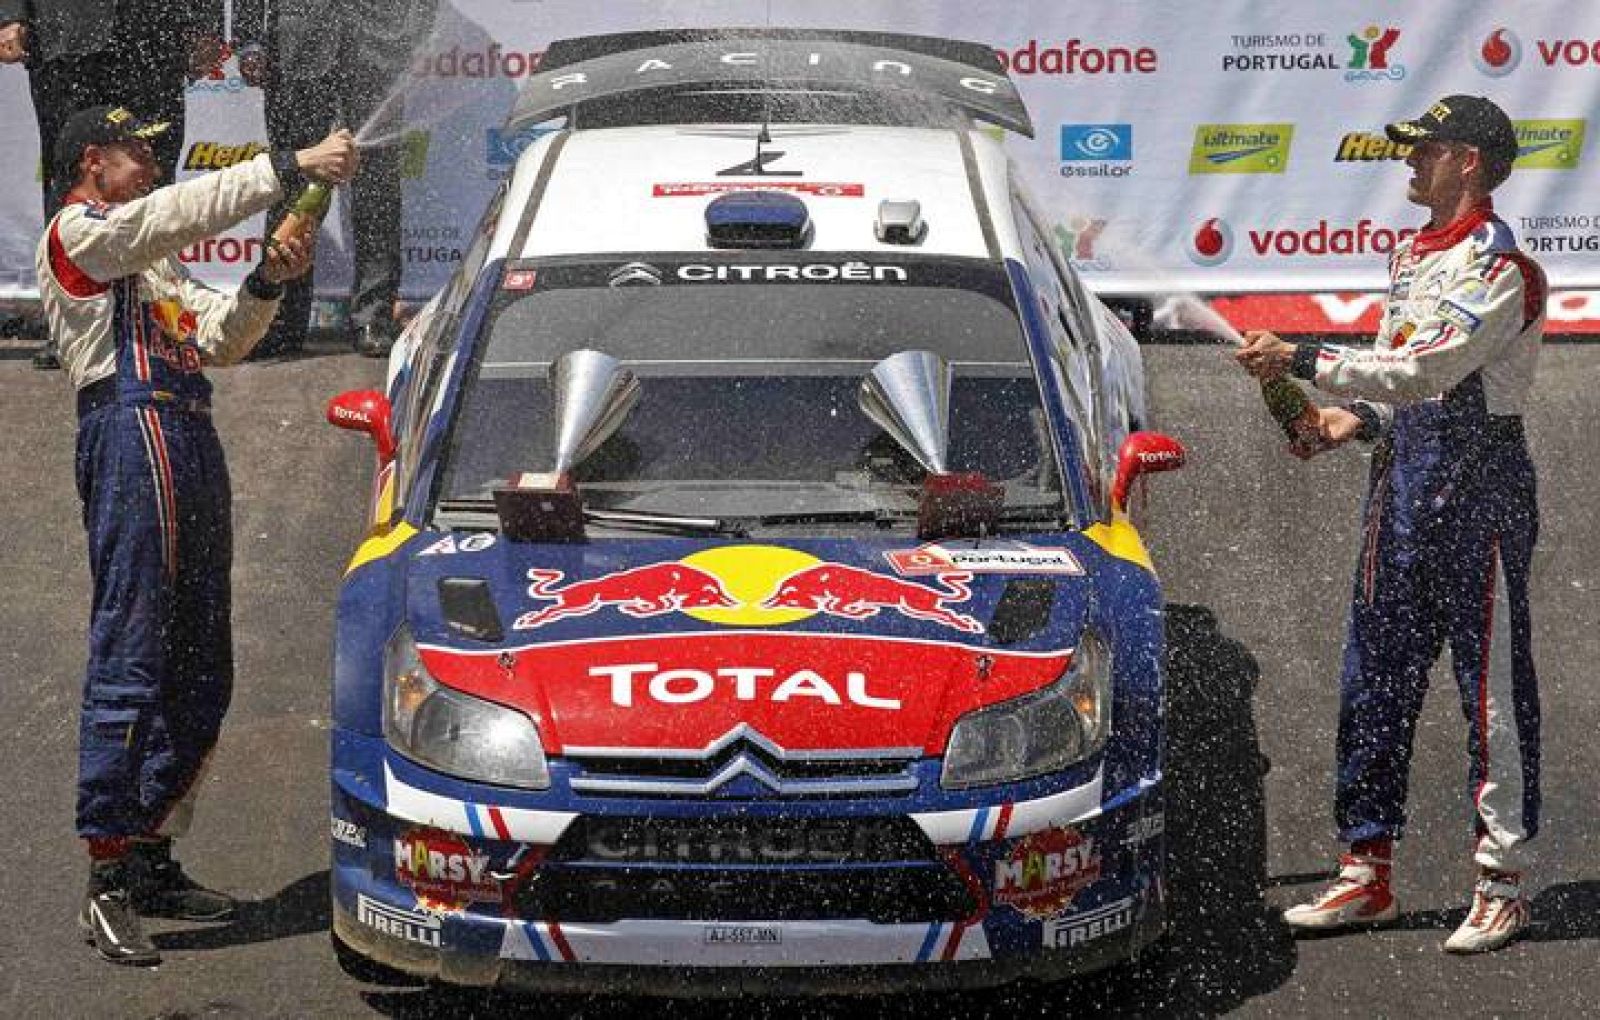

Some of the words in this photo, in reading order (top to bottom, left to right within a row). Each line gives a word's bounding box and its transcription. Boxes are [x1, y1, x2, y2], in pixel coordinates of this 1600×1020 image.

[1230, 34, 1301, 48] TURISMO
[1304, 33, 1326, 47] DE
[1222, 53, 1341, 71] PORTUGAL
[1204, 130, 1281, 146] ultimate
[1060, 164, 1132, 178] essilor
[1521, 215, 1590, 229] TURISMO
[333, 405, 372, 423] TOTAL
[588, 662, 902, 710] TOTAL
[393, 838, 490, 885] MARSY
[994, 837, 1094, 894] MARSY
[357, 892, 442, 948] PIRELLI
[1041, 897, 1133, 949] PIRELLI
